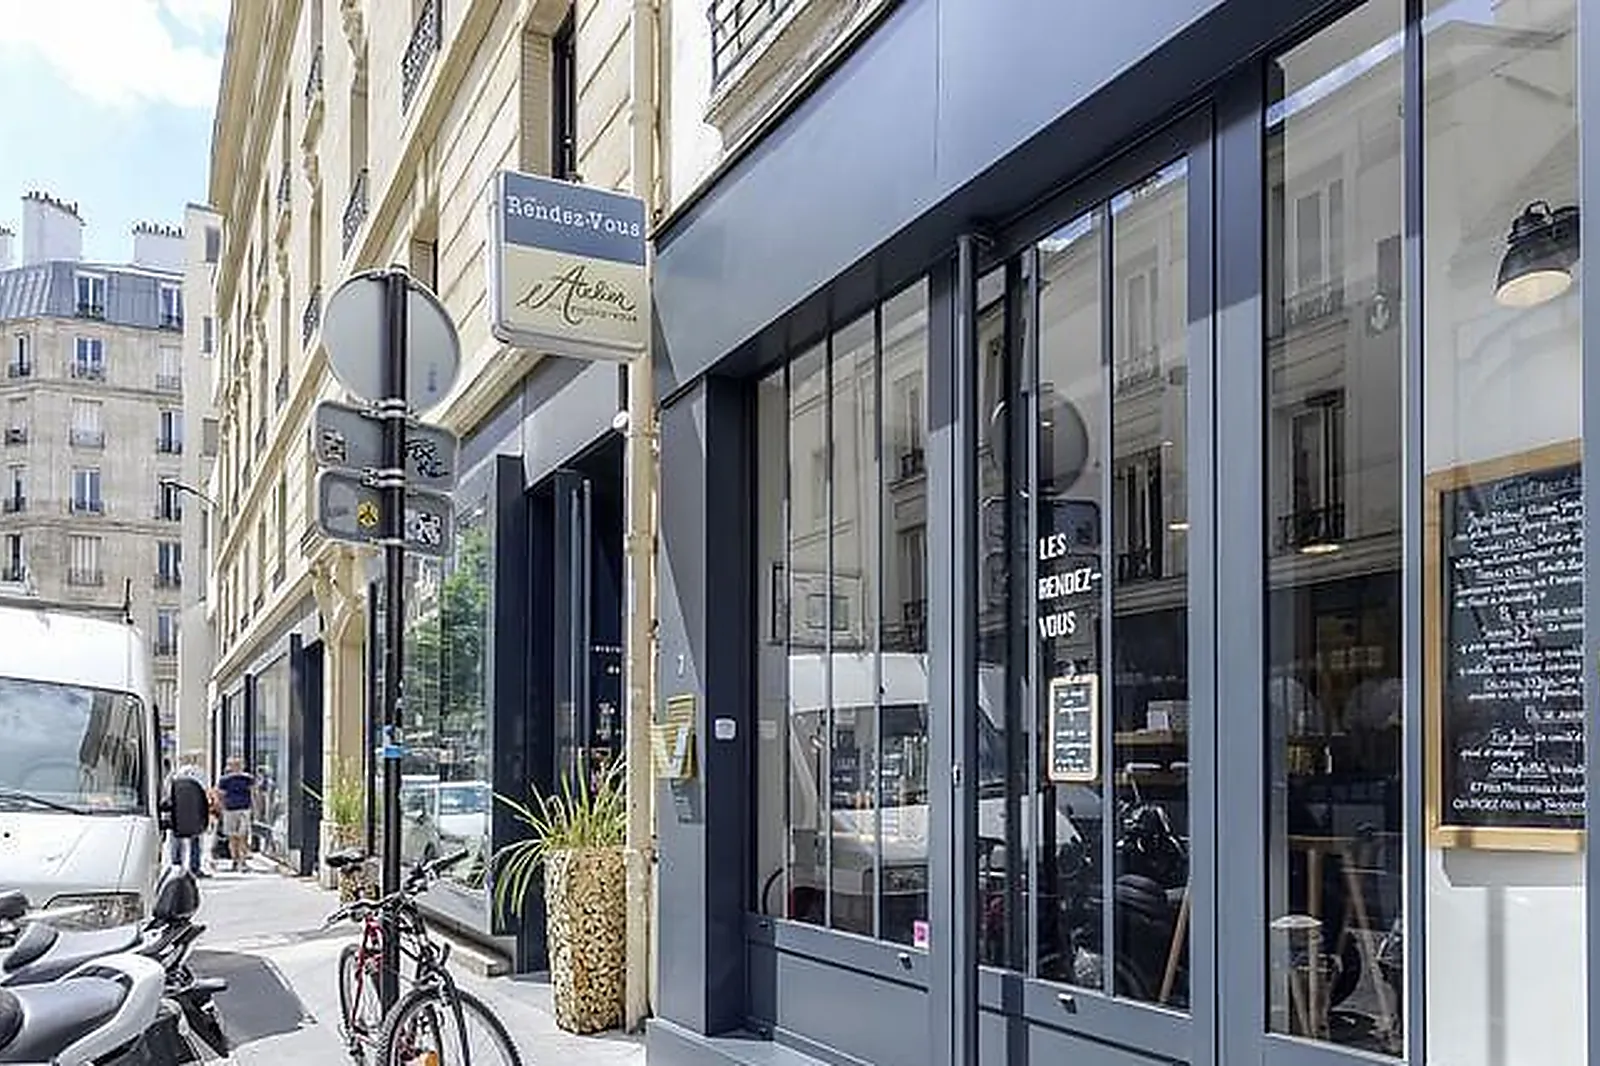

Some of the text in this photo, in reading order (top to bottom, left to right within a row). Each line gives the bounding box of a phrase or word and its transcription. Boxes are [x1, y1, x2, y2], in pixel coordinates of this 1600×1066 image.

[1040, 532, 1067, 560] LES
[1039, 567, 1101, 600] RENDEZ-
[1039, 610, 1076, 638] VOUS
